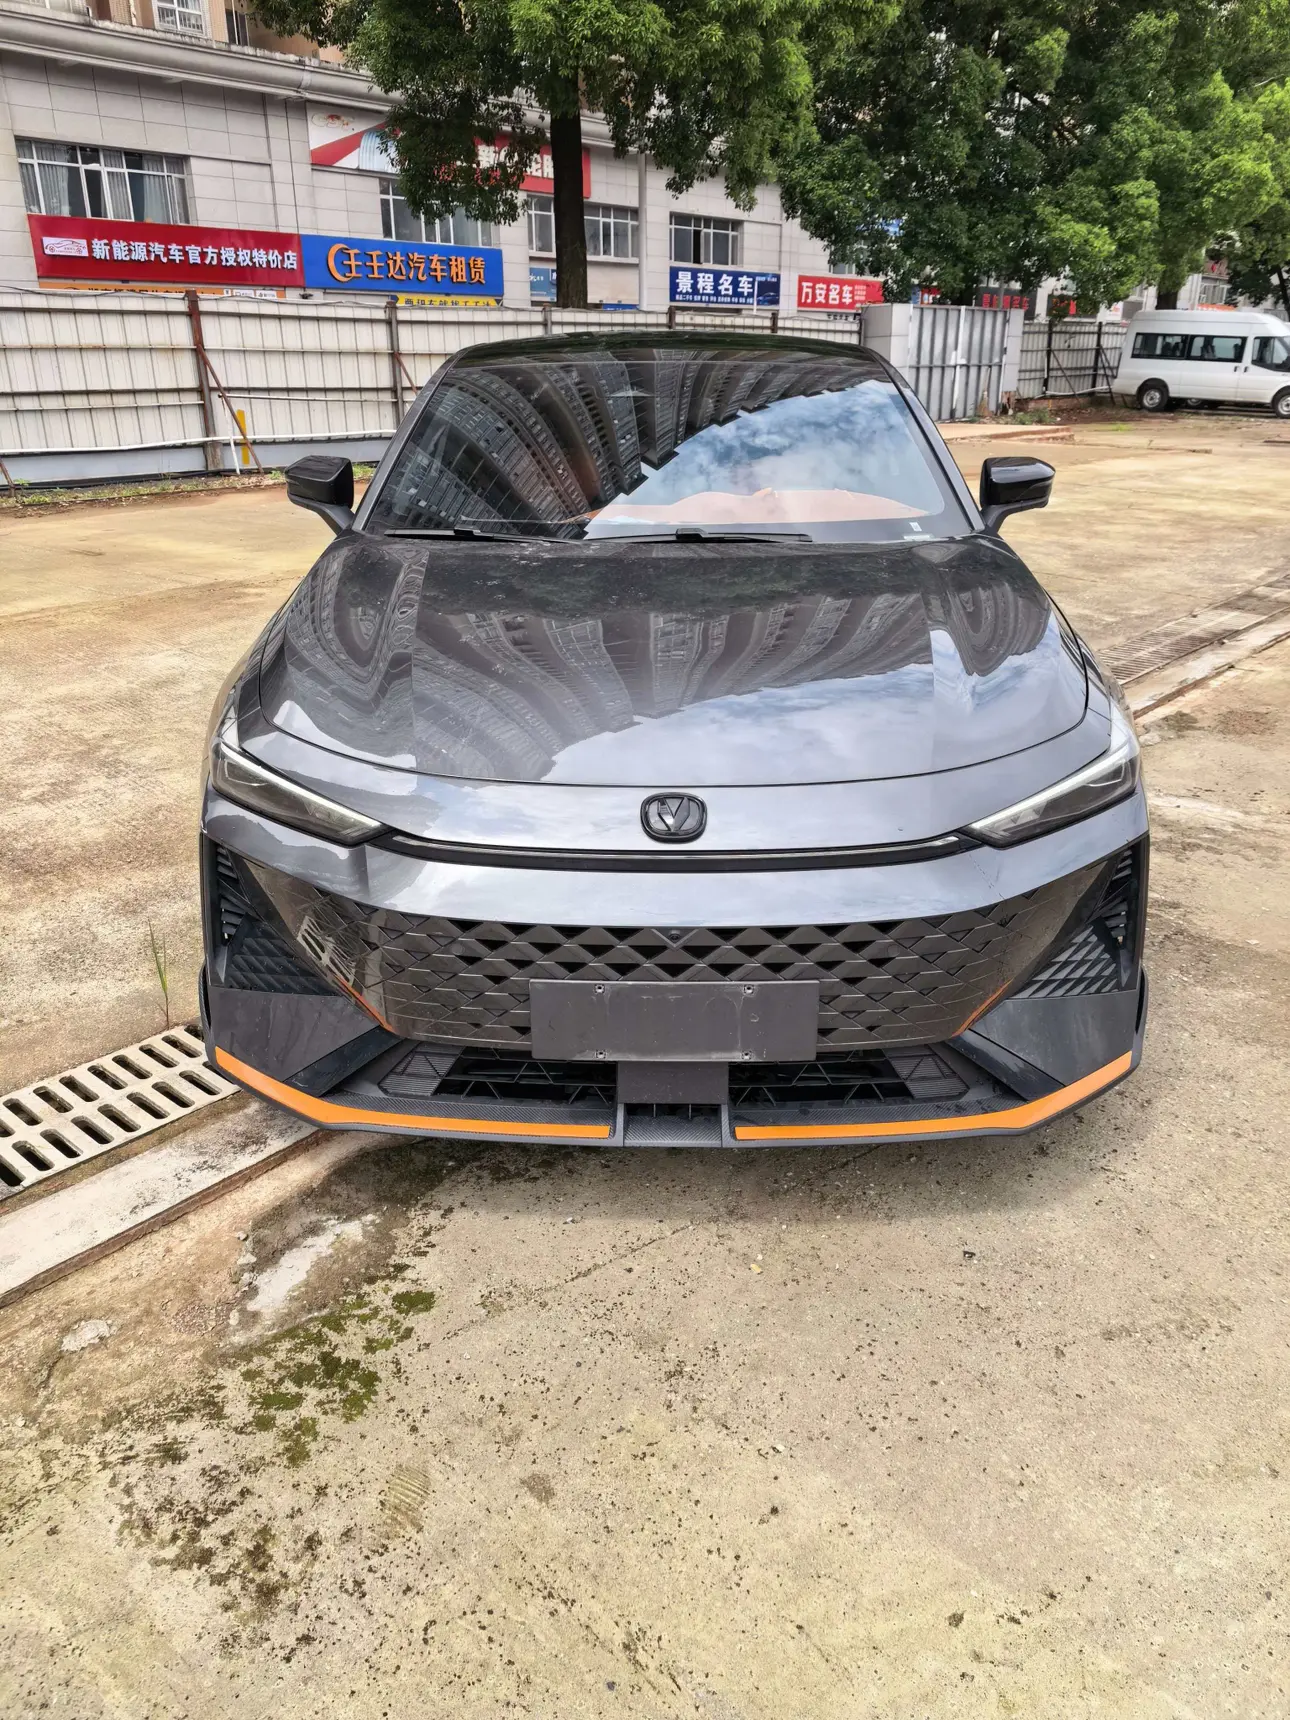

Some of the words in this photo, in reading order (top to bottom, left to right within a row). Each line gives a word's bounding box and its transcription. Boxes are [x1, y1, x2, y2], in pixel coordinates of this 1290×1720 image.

[91, 238, 298, 271] 新能源汽车官方授权特价店
[676, 271, 754, 297] 景程名车
[801, 281, 853, 305] 万安名车
